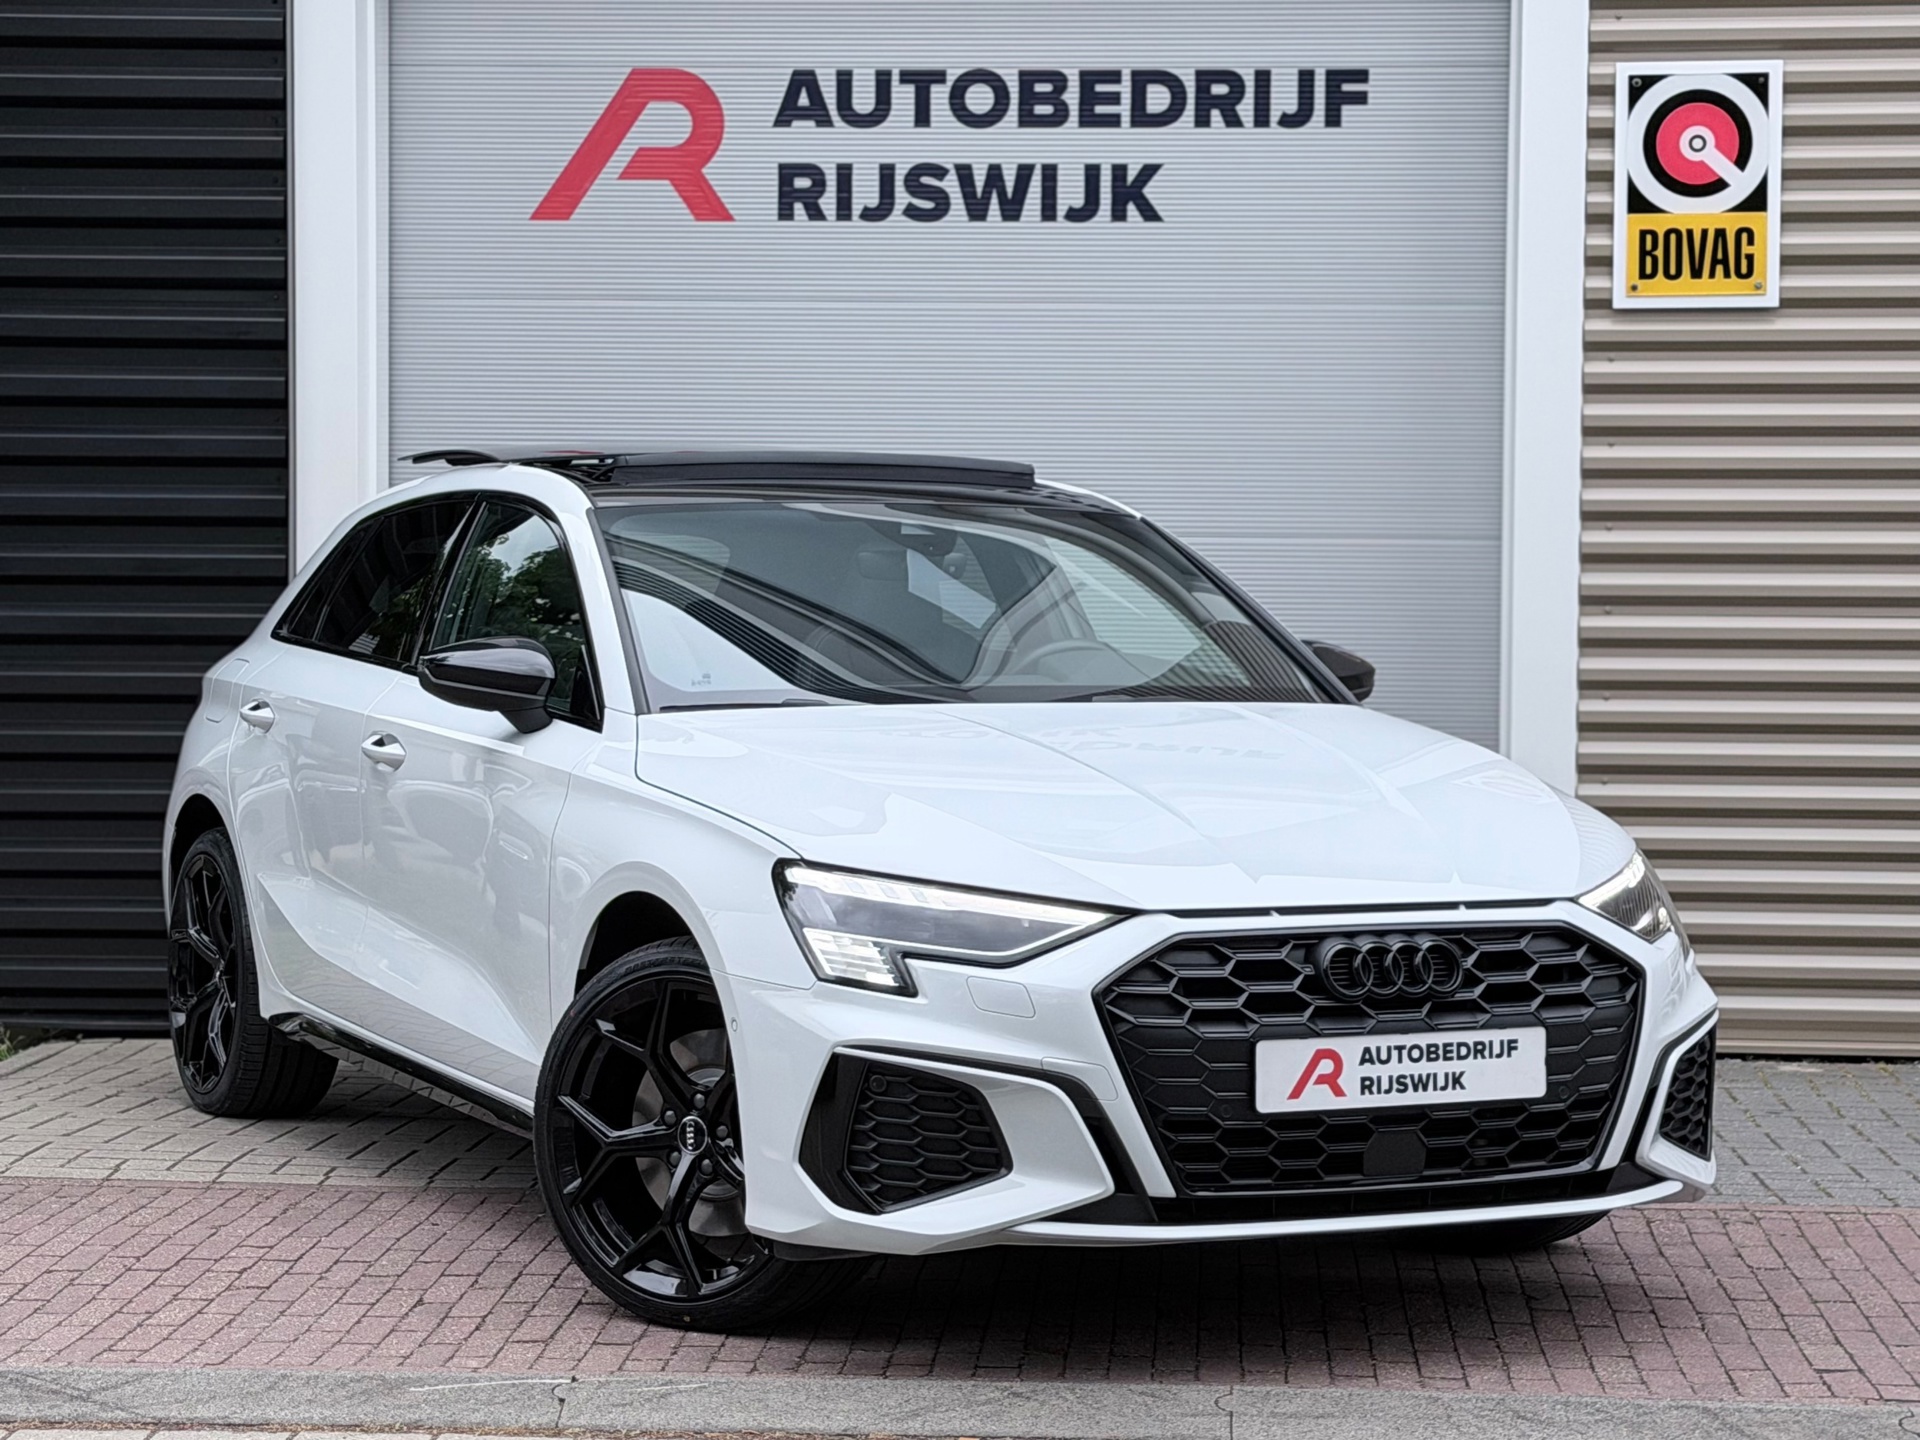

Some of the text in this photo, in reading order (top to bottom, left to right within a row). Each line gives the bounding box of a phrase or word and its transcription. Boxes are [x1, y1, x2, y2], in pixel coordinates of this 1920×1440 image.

[772, 68, 1370, 129] AUTOBEDRIJF
[777, 162, 1164, 223] RIJSWIJK
[1638, 226, 1756, 281] BOVAG
[1358, 1038, 1519, 1067] AUTOBEDRIJF
[1359, 1070, 1467, 1097] RIJSWIJK
